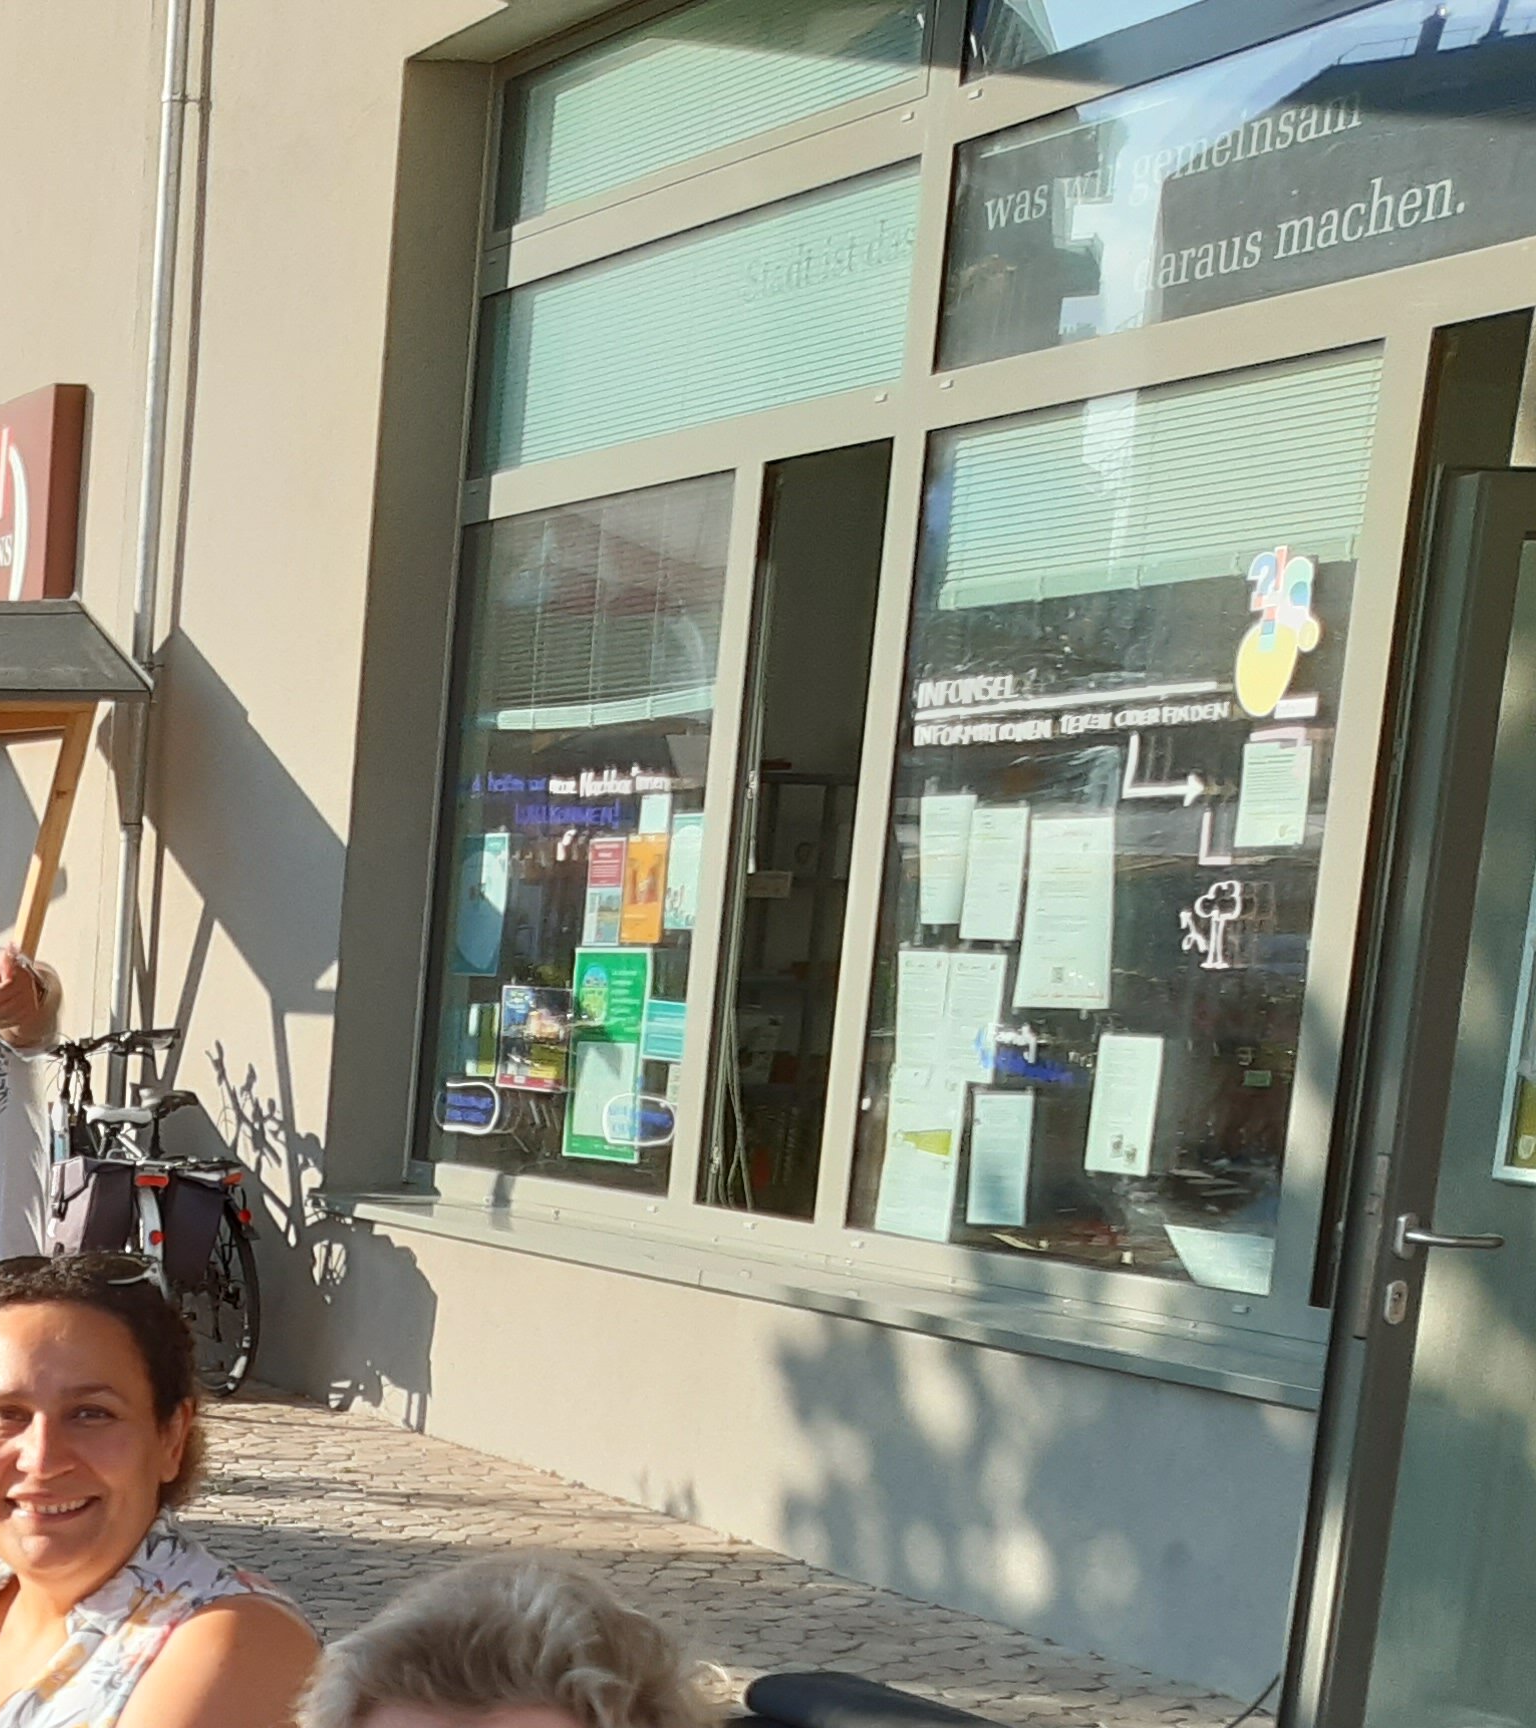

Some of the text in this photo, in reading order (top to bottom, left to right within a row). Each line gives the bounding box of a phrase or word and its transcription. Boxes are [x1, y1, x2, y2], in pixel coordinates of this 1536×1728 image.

[984, 184, 1048, 232] was
[1133, 91, 1362, 208] gemeinsam
[1134, 176, 1467, 294] daraus machen.
